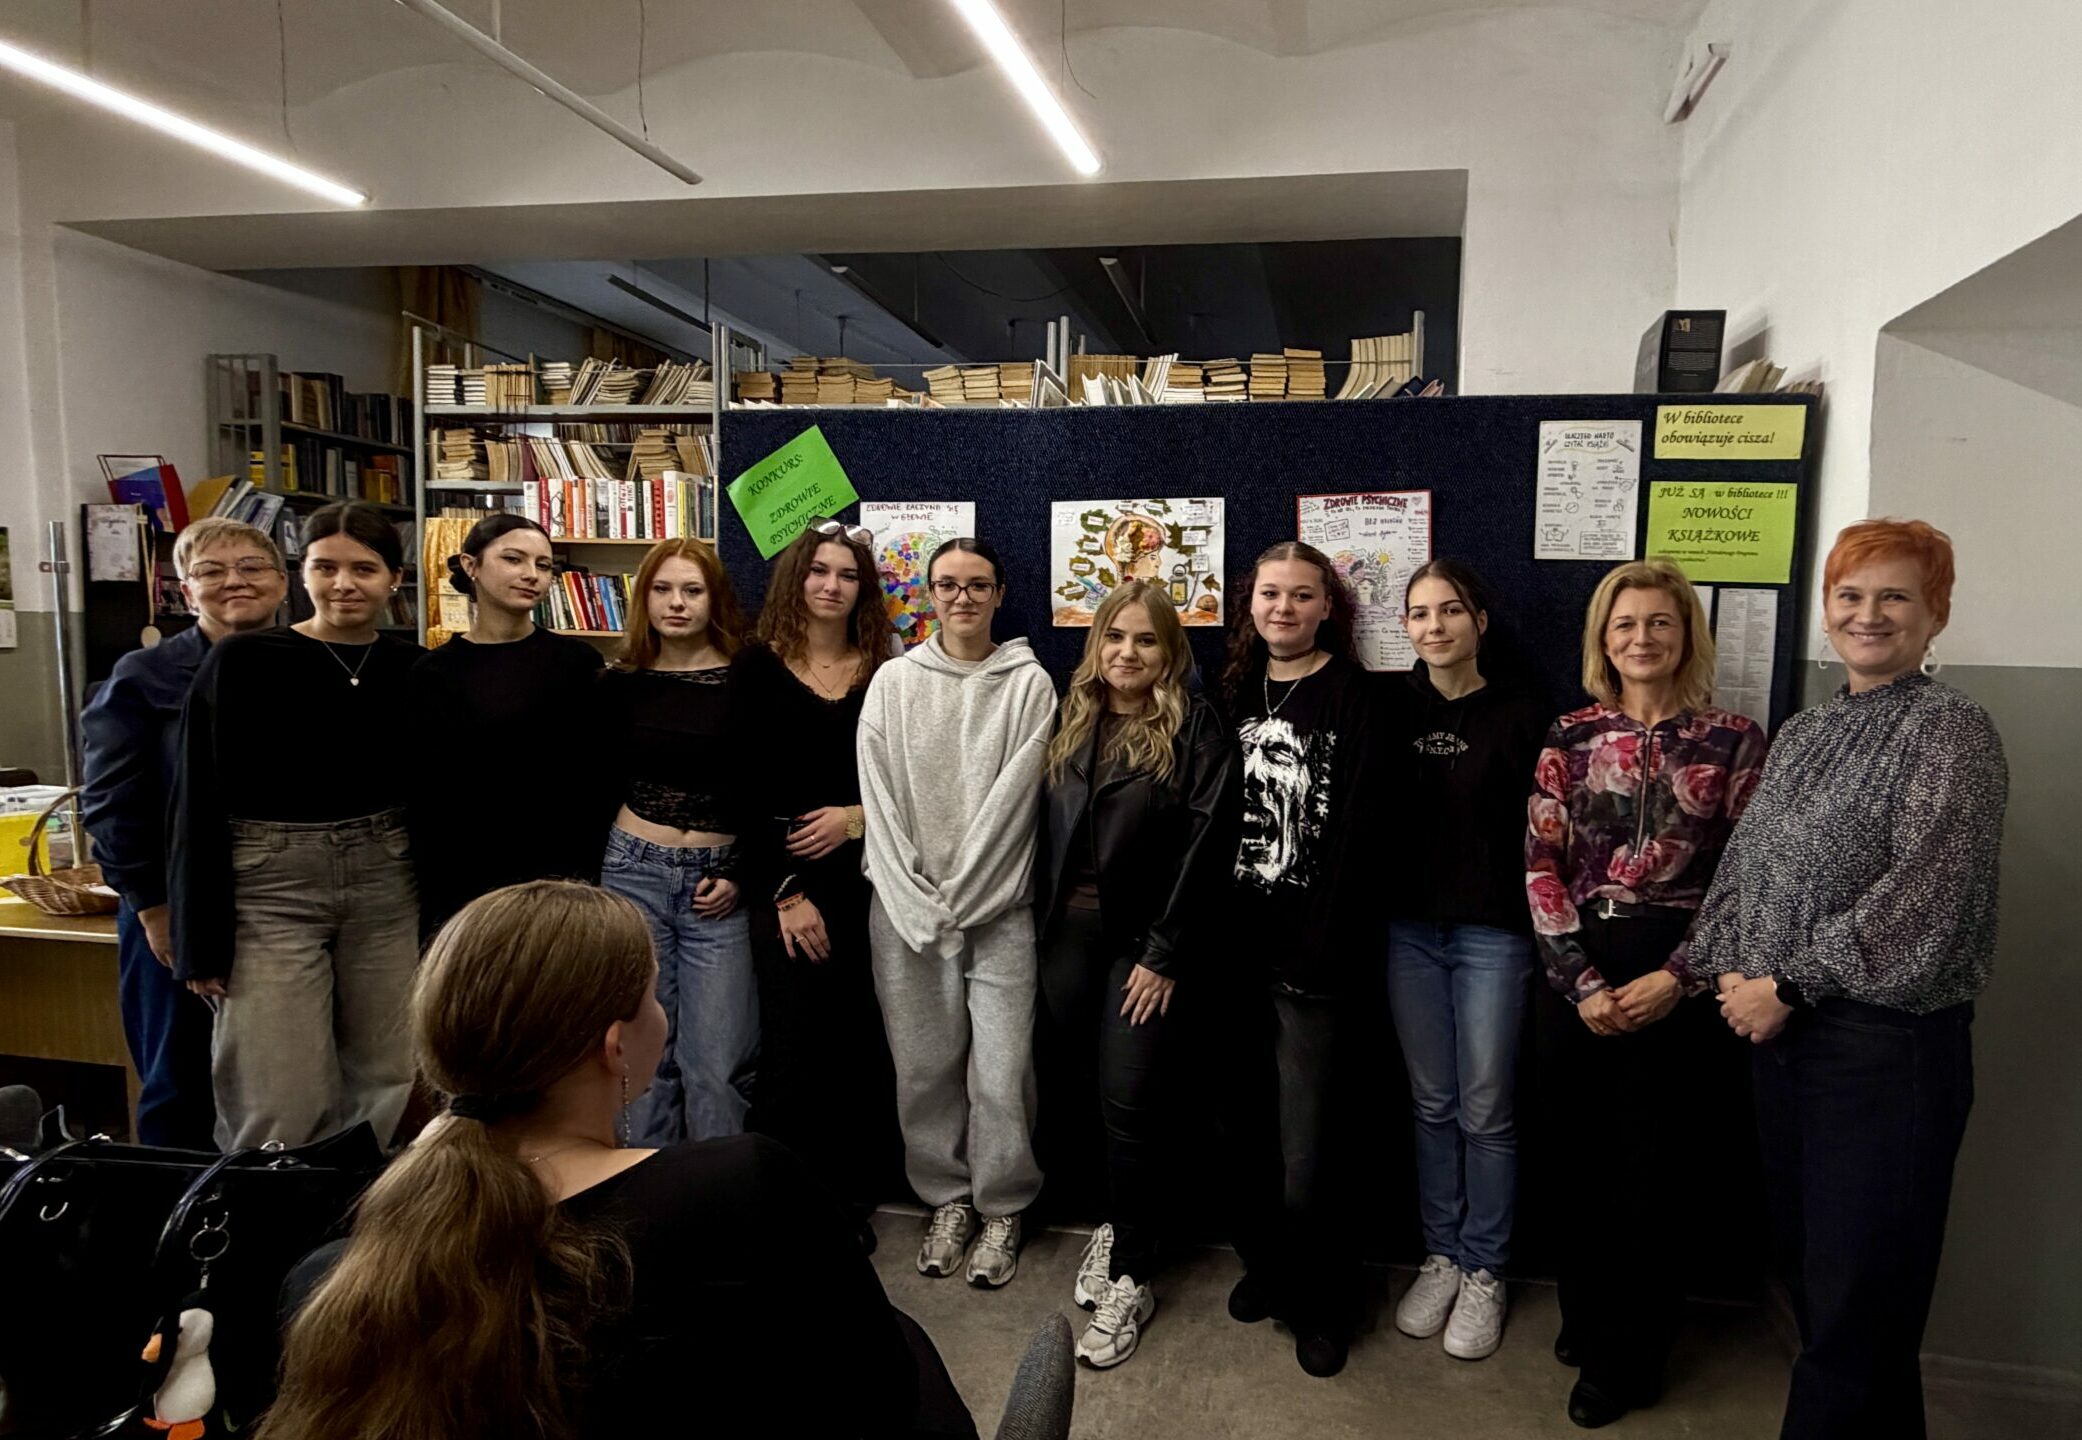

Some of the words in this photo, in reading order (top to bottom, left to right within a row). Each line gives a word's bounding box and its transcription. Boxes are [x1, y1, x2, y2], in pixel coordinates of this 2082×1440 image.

[1663, 411, 1681, 424] W
[1683, 410, 1744, 424] bibliotece
[1661, 430, 1734, 447] obowiązuje
[1737, 431, 1775, 444] cisza!
[1658, 486, 1685, 498] JUŻ
[1688, 487, 1706, 499] SĄ
[1714, 489, 1725, 498] w
[1727, 487, 1773, 498] bibliotece
[1776, 489, 1788, 499] !!!
[769, 482, 821, 524] ZDROWIE
[1323, 495, 1359, 510] ZDROWIE
[1361, 495, 1408, 509] PSYCHICZNE
[769, 495, 837, 545] PSYCHICZNE
[1682, 505, 1754, 520] NOWOŚCI
[1667, 528, 1760, 543] KSIĄŻKOWE
